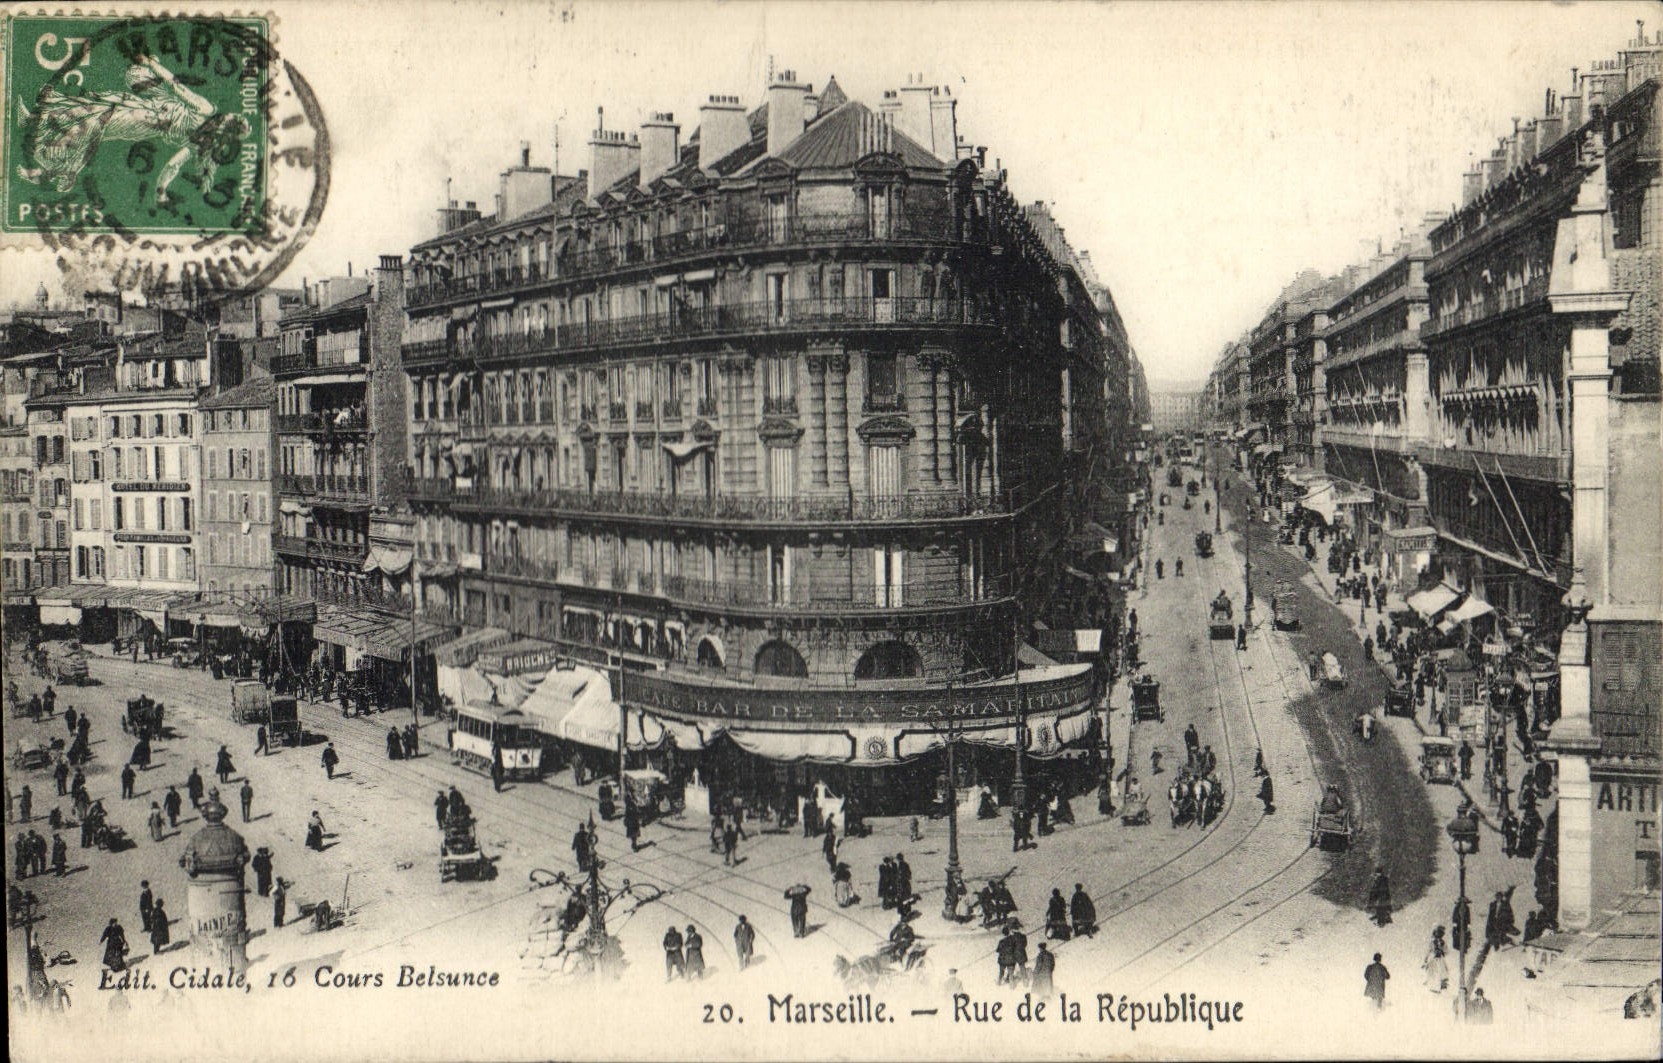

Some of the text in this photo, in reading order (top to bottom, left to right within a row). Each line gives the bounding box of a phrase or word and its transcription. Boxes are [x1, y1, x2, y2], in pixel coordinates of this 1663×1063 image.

[18, 202, 105, 224] POSTES
[696, 699, 752, 718] BAR
[772, 703, 814, 718] DE
[836, 703, 881, 718] LA
[900, 686, 1086, 718] SAMAITAIN
